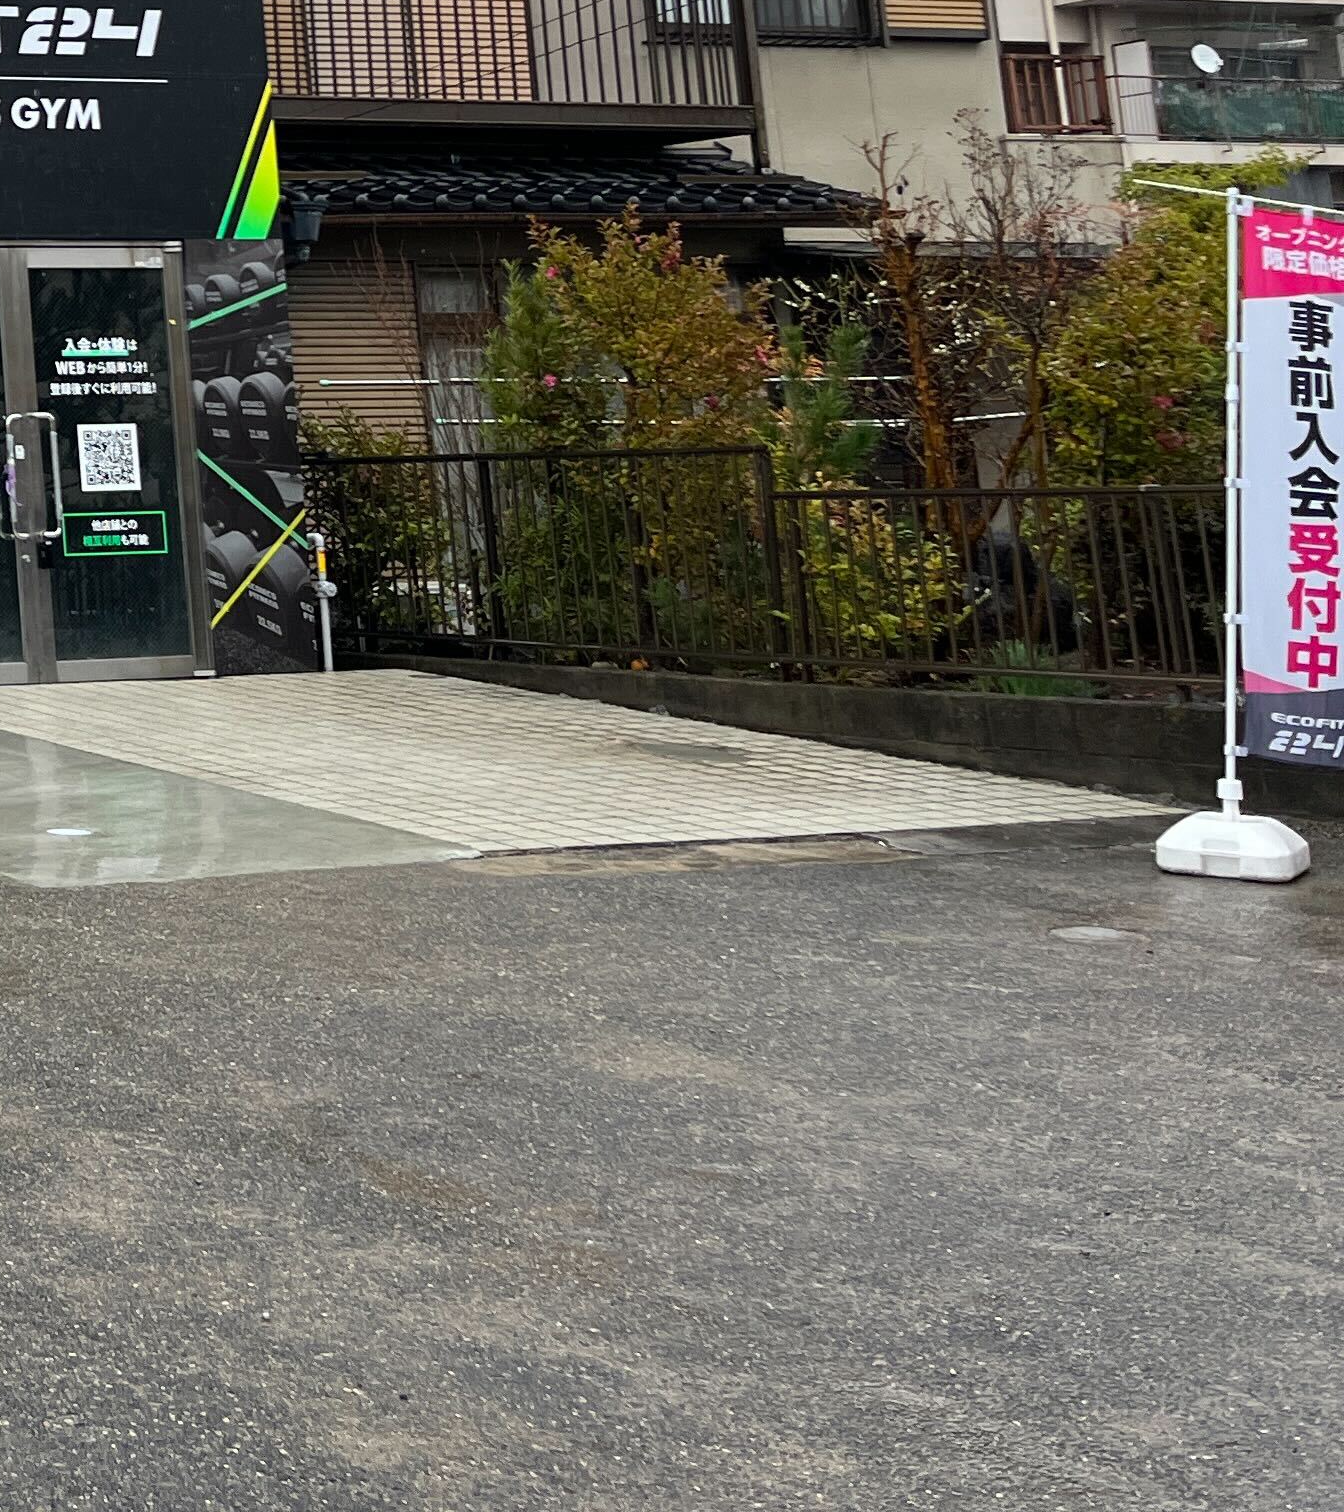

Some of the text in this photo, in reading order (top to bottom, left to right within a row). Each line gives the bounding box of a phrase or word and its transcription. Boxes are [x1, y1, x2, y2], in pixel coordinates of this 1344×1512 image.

[11, 99, 102, 131] GYM
[1287, 299, 1341, 688] 事前入会受付中
